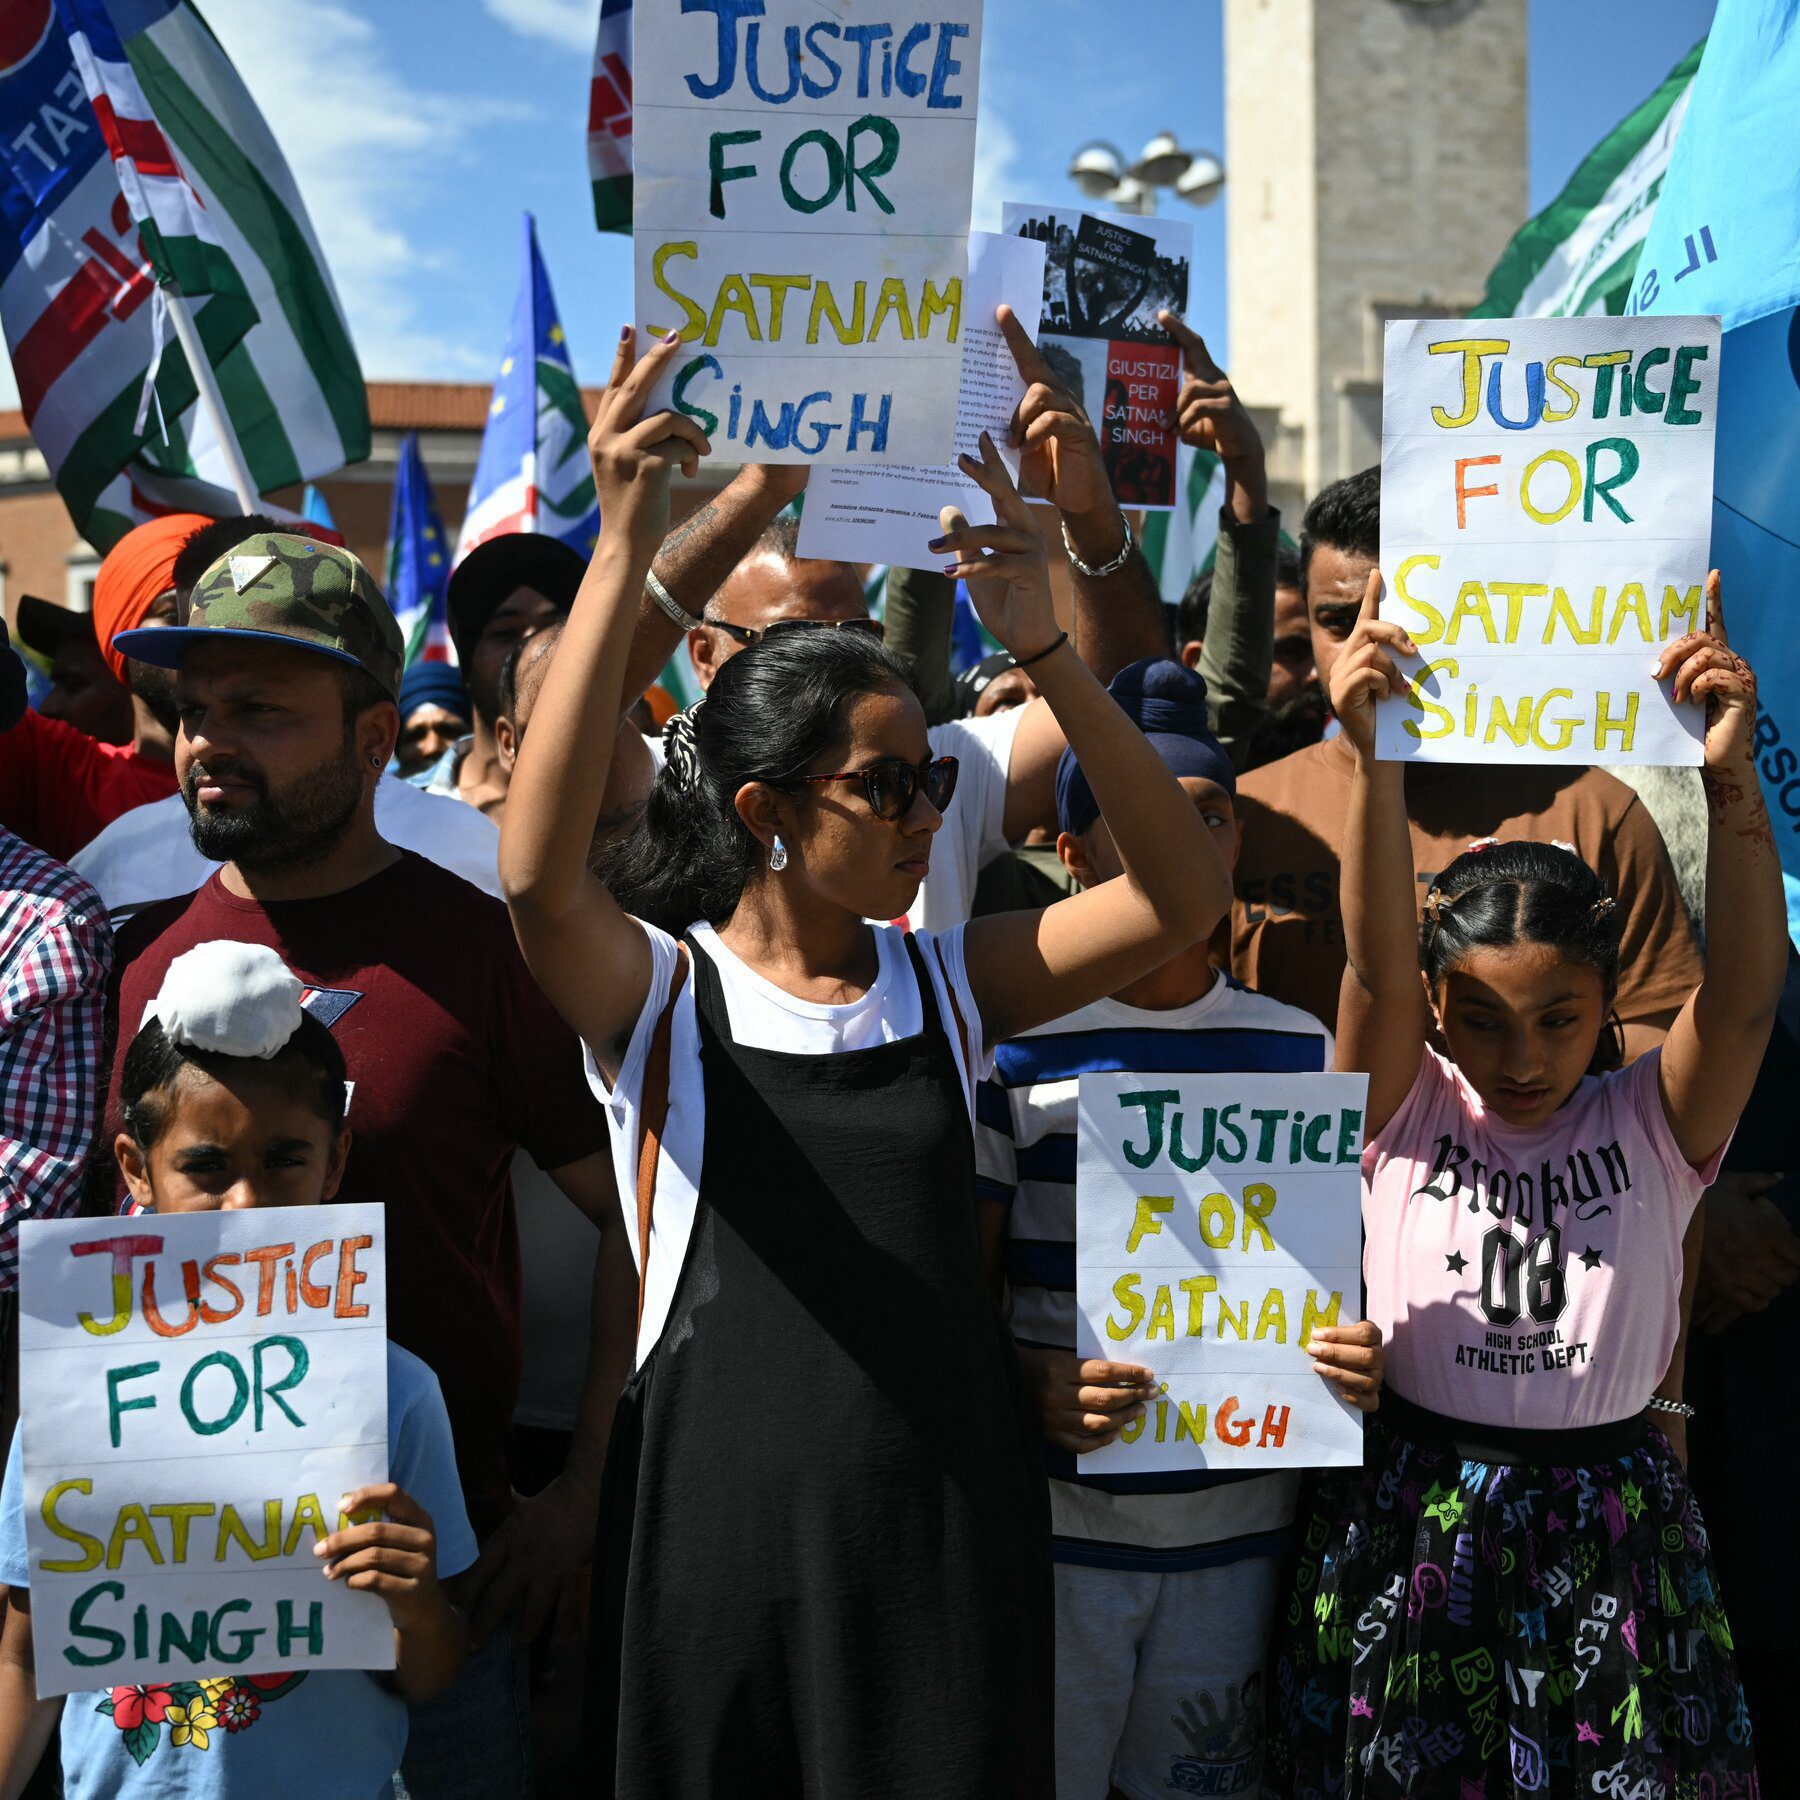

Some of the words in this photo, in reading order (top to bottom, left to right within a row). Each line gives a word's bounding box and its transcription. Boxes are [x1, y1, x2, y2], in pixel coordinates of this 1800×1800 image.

[709, 113, 900, 219] FOR
[1104, 240, 1124, 254] FOR
[646, 241, 963, 346] SATNAM
[1128, 384, 1158, 400] PER
[1112, 427, 1163, 445] SINGH
[1454, 437, 1640, 530] FOR
[1394, 554, 1702, 646] SATNAM
[1125, 1182, 1276, 1254] FOR
[1478, 1222, 1570, 1328] 08
[1455, 1344, 1535, 1375] ATHLETIC
[1485, 1331, 1511, 1350] HIGH
[1517, 1329, 1564, 1350] SCHOOL
[105, 1333, 309, 1448] FOR
